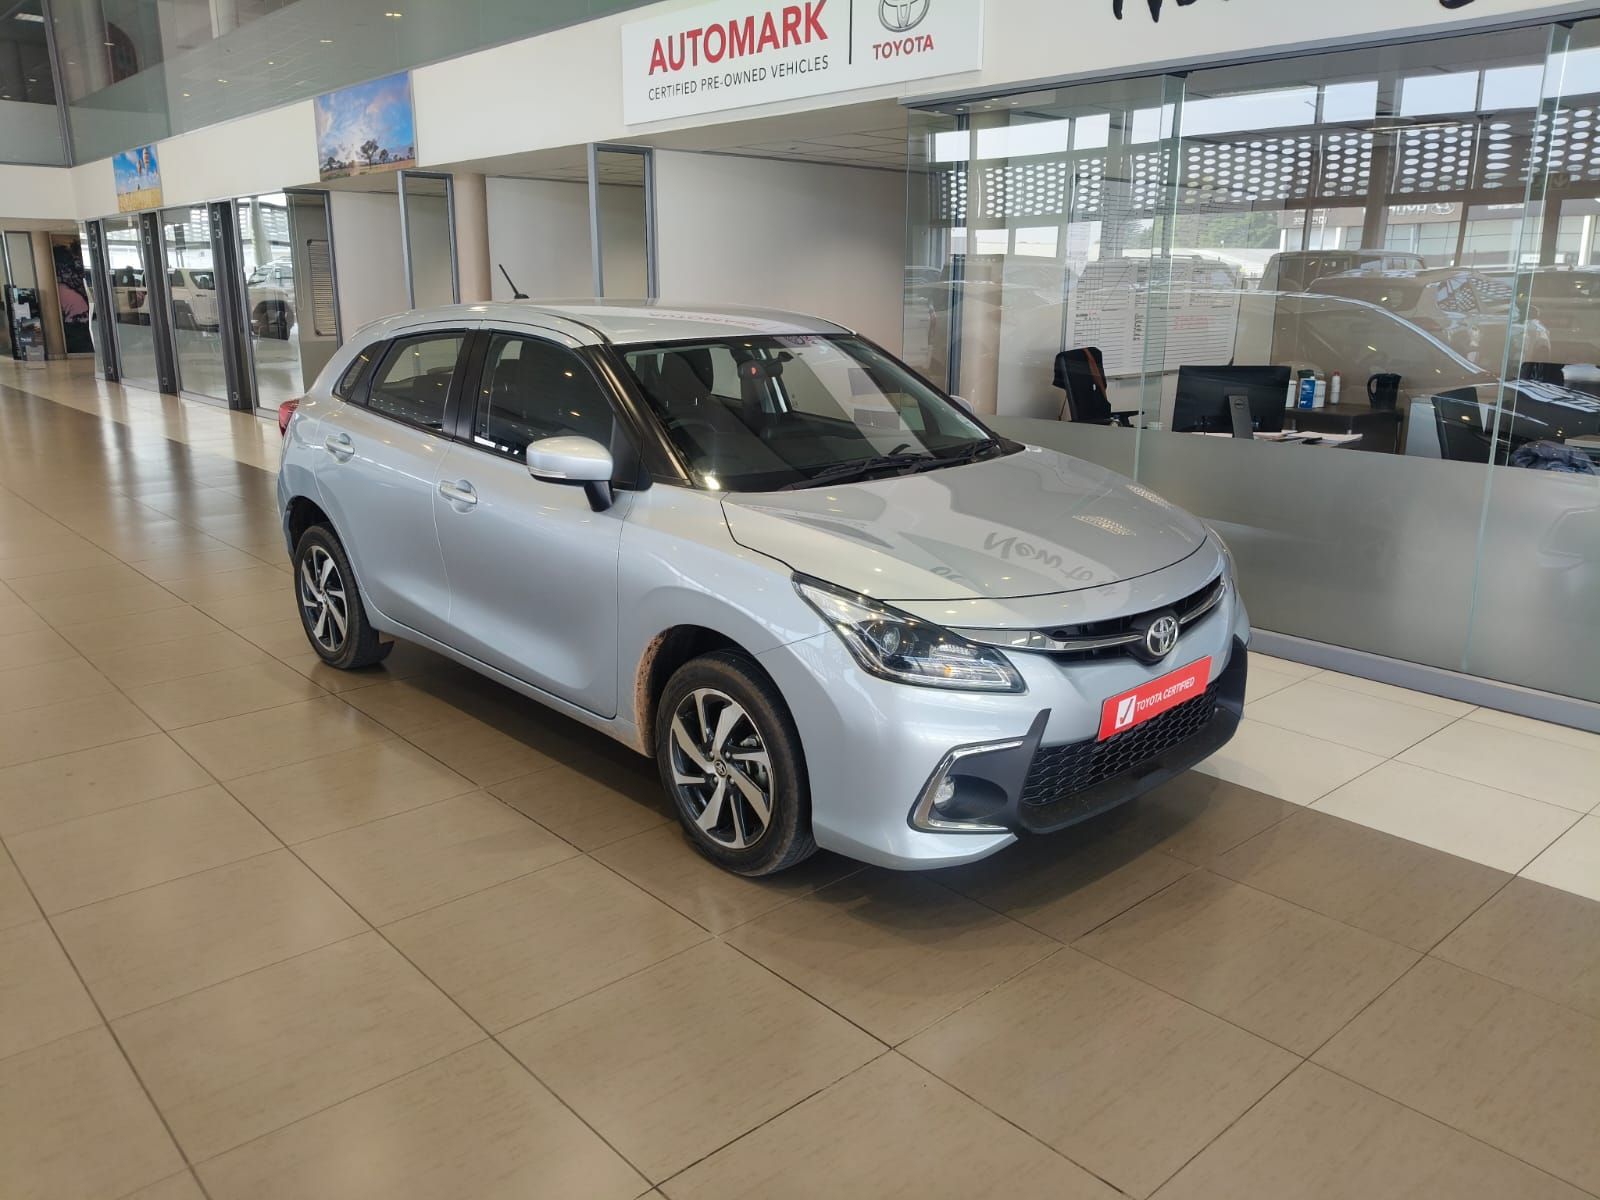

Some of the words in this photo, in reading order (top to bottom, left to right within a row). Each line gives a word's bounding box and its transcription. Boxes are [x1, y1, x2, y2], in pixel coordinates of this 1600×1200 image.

[649, 0, 829, 76] AUTOMARK
[872, 34, 934, 60] TOYOTA
[648, 79, 698, 101] CERTIFIED
[700, 67, 767, 92] PRE-OWNED
[770, 55, 830, 79] VEHICLES
[1136, 692, 1162, 712] TOYOTA
[1163, 676, 1196, 700] CERTIFIED
